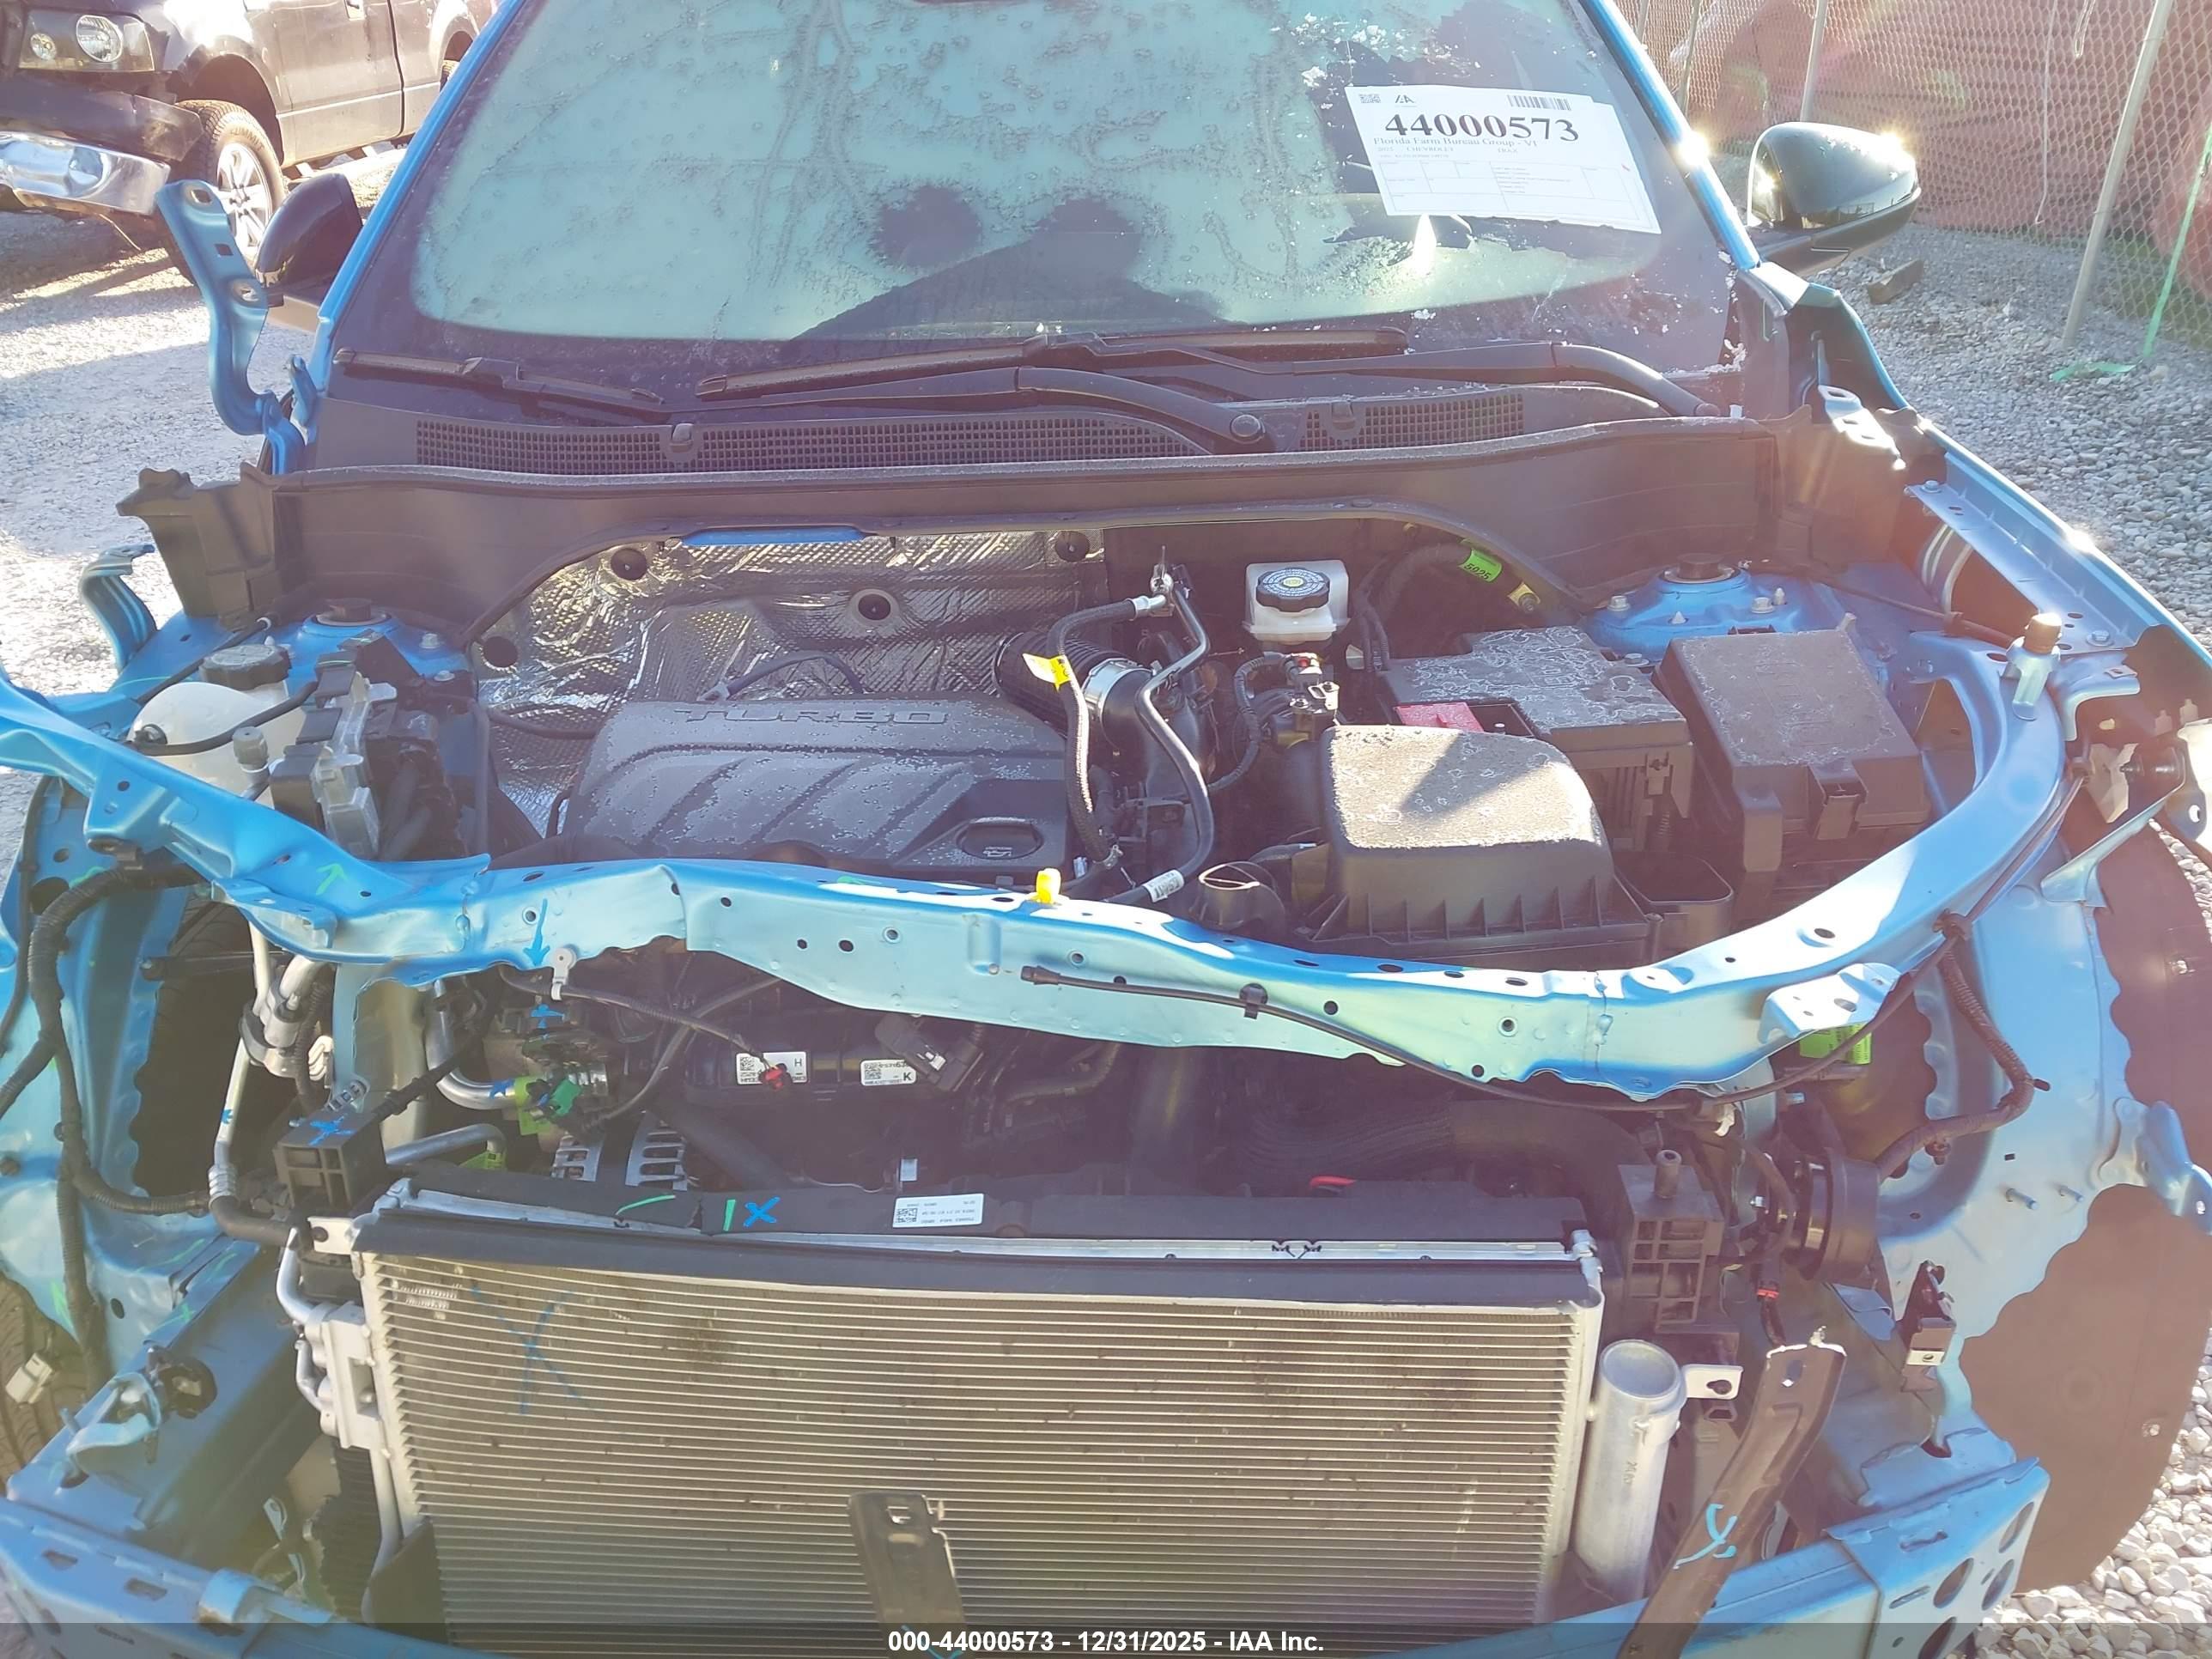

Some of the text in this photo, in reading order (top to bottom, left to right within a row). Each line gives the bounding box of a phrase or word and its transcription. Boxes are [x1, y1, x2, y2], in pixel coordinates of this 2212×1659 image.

[1385, 113, 1579, 142] 44000573
[1443, 137, 1480, 146] Bureau
[1482, 138, 1516, 147] Group
[673, 708, 948, 725] TURBO
[794, 1057, 803, 1067] H
[902, 1072, 913, 1081] K
